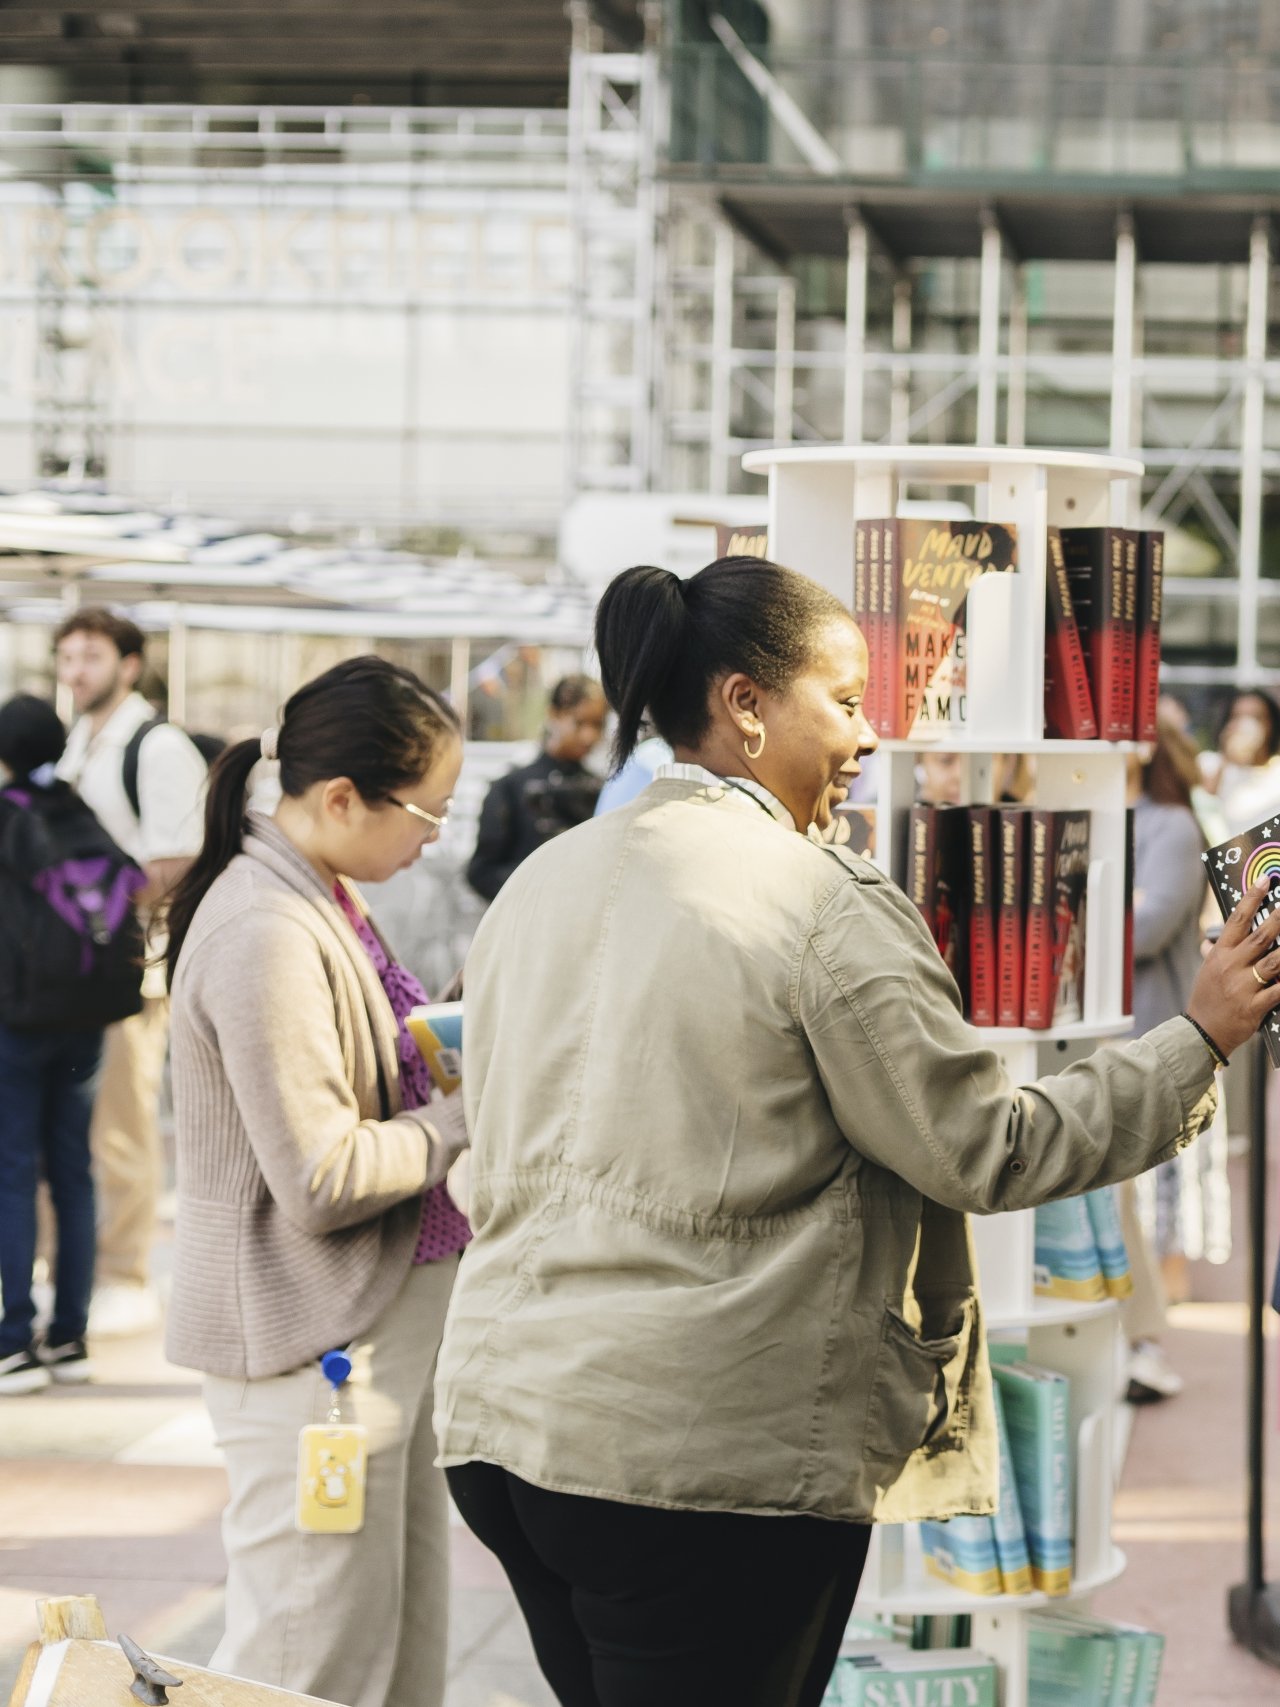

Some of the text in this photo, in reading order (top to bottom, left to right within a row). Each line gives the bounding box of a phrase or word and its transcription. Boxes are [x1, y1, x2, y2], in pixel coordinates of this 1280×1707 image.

[918, 528, 993, 560] MAUD
[903, 559, 1015, 589] VENTU
[906, 633, 966, 659] MAKE
[906, 665, 934, 689] ME
[865, 1675, 978, 1707] SALTY
